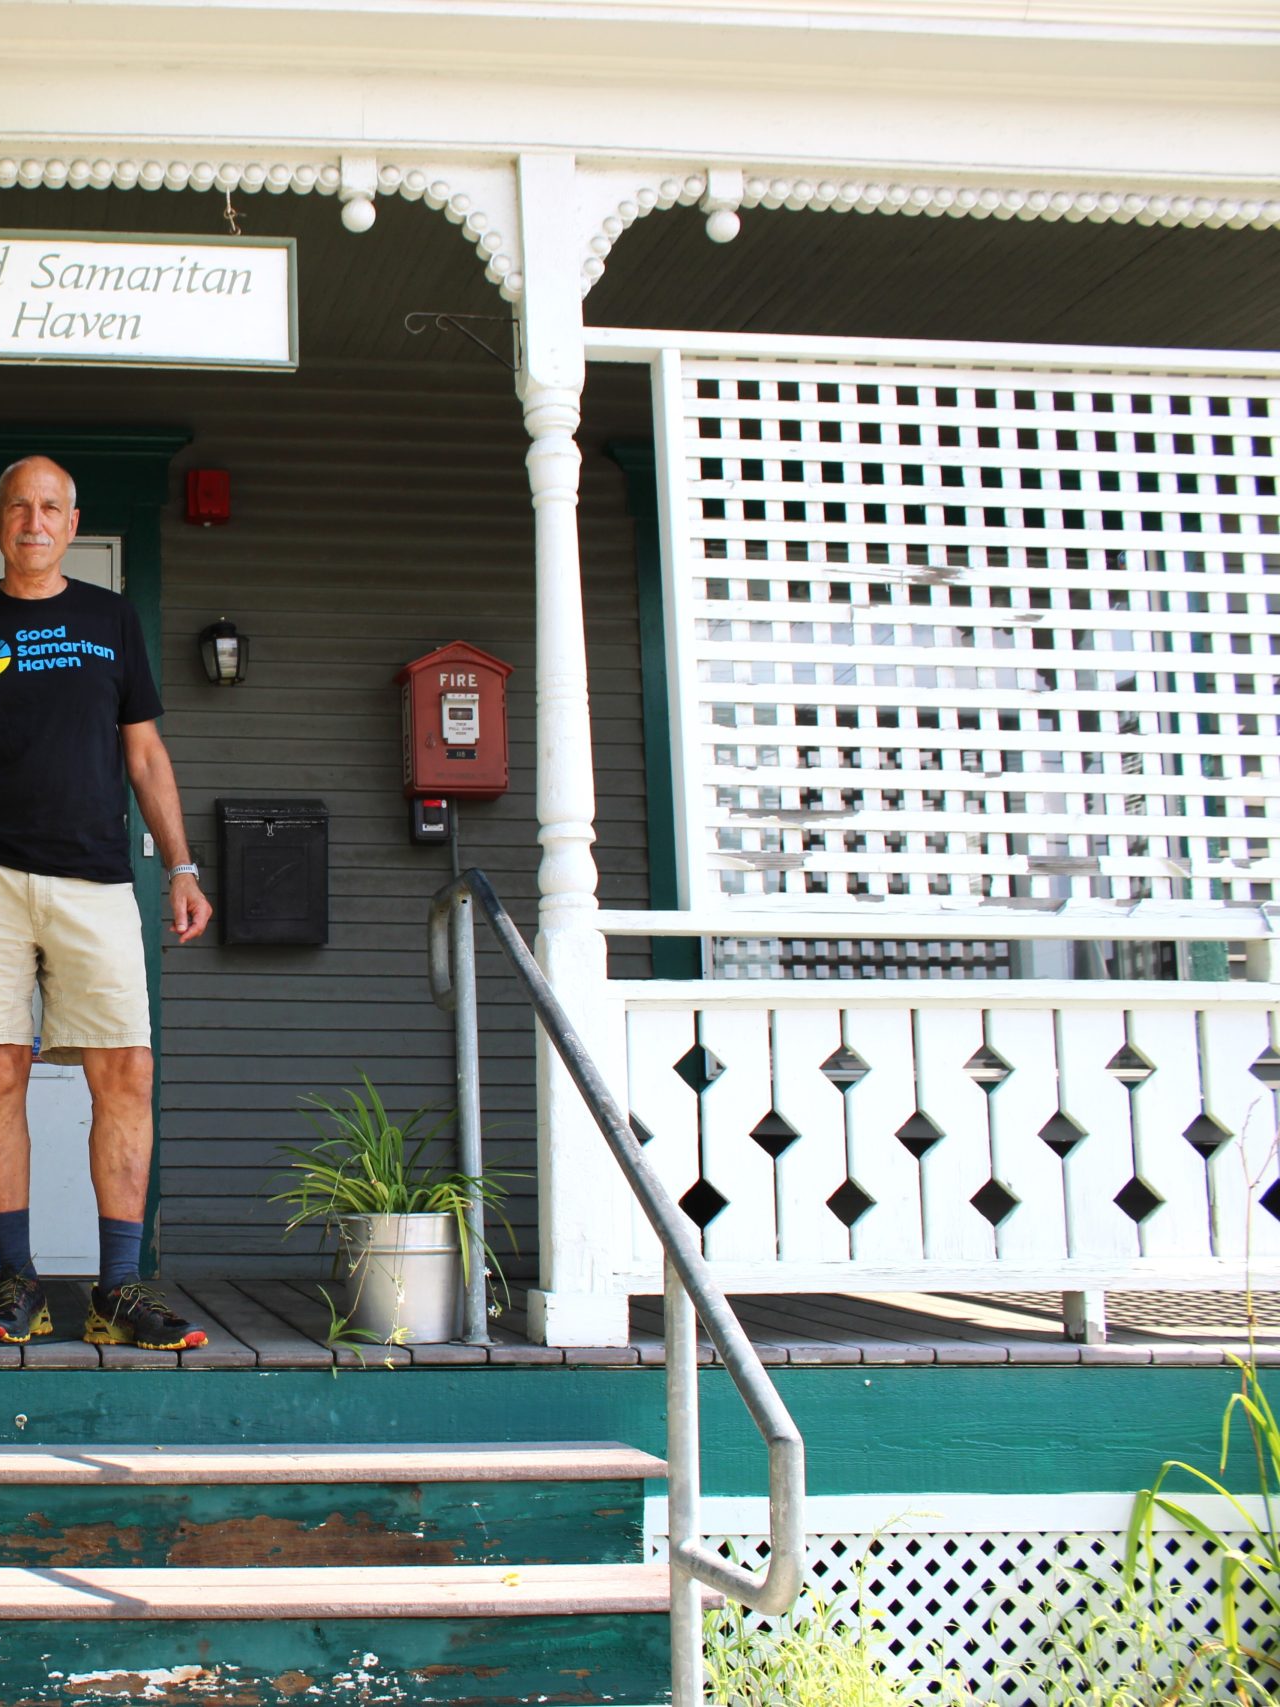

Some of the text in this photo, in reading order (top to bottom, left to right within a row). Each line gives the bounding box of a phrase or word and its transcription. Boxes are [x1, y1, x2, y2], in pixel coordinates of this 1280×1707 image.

[31, 253, 253, 296] Samaritan
[11, 301, 142, 341] Haven
[15, 625, 67, 642] Good
[17, 640, 115, 661] Samaritan
[18, 656, 82, 672] Haven
[439, 673, 478, 687] FIRE
